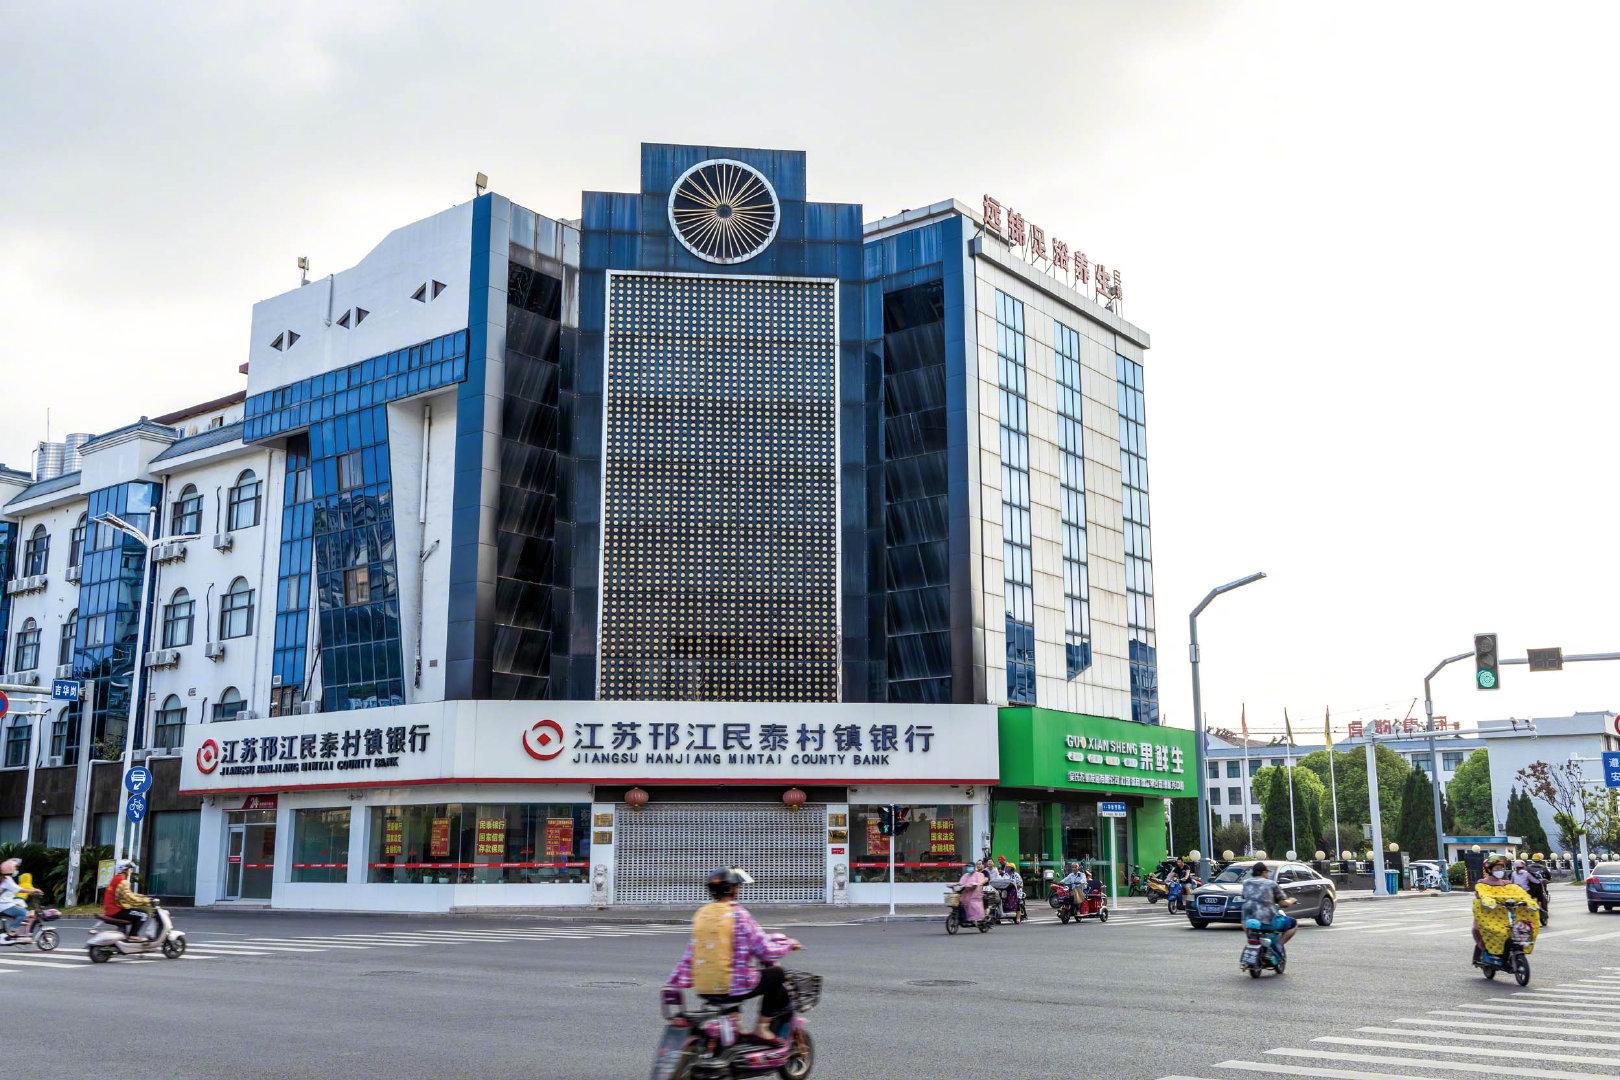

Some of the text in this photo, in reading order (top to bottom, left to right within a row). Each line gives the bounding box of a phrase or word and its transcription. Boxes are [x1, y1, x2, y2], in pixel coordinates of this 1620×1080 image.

[221, 724, 431, 764] 江苏邗江民泰村镇银行
[573, 721, 935, 753] 江苏邗江民泰村镇银行
[1088, 738, 1109, 752] XIAN
[1110, 740, 1138, 755] SHENG
[337, 758, 371, 771] COUNTY
[374, 756, 400, 769] BANK
[573, 753, 890, 766] JIANGSU HANJIANG MINTAI COUNTY BANK
[1139, 742, 1185, 774] 果鲜生
